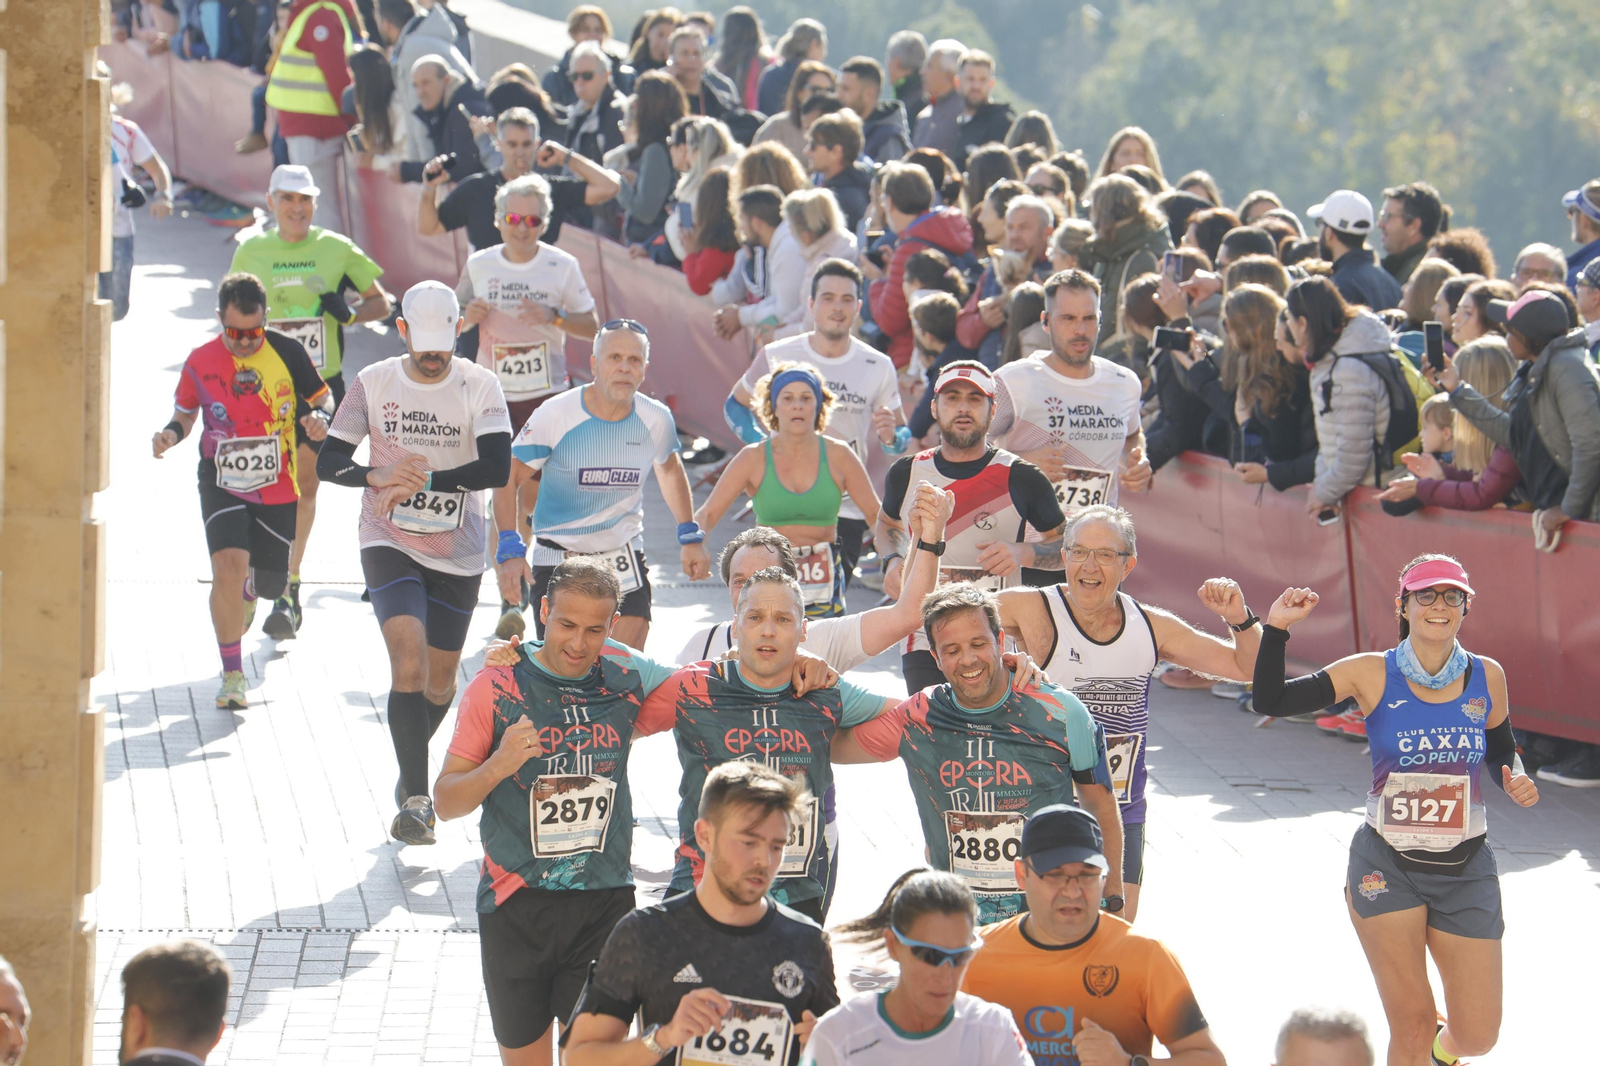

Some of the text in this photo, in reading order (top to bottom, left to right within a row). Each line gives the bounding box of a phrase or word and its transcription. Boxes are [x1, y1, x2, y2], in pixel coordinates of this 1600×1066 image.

[501, 283, 529, 291] MEDIA
[501, 357, 542, 375] 4213
[401, 410, 438, 423] MEDIA
[1067, 405, 1104, 416] MEDIA
[384, 421, 398, 433] 37
[1048, 415, 1065, 428] 37
[1069, 413, 1124, 429] MARATÓN
[401, 422, 461, 436] MARATÓN
[1068, 430, 1109, 441] CÓRDOBA
[402, 436, 461, 448] CÓRDOBA 2023
[221, 455, 276, 471] 4028
[1054, 485, 1102, 507] 4738
[1088, 704, 1129, 713] ORIA
[537, 723, 621, 754] EPORA
[1396, 727, 1484, 738] CLUB ATLETISMO
[724, 727, 812, 754] EPORA
[1398, 734, 1484, 753] CAXAR
[939, 759, 1033, 788] EPORA
[996, 788, 1032, 797] MMXXIII
[540, 795, 609, 825] 2879
[1391, 797, 1457, 822] 5127
[953, 834, 1022, 862] 2880
[673, 974, 702, 983] adidas
[694, 1028, 775, 1062] 1684
